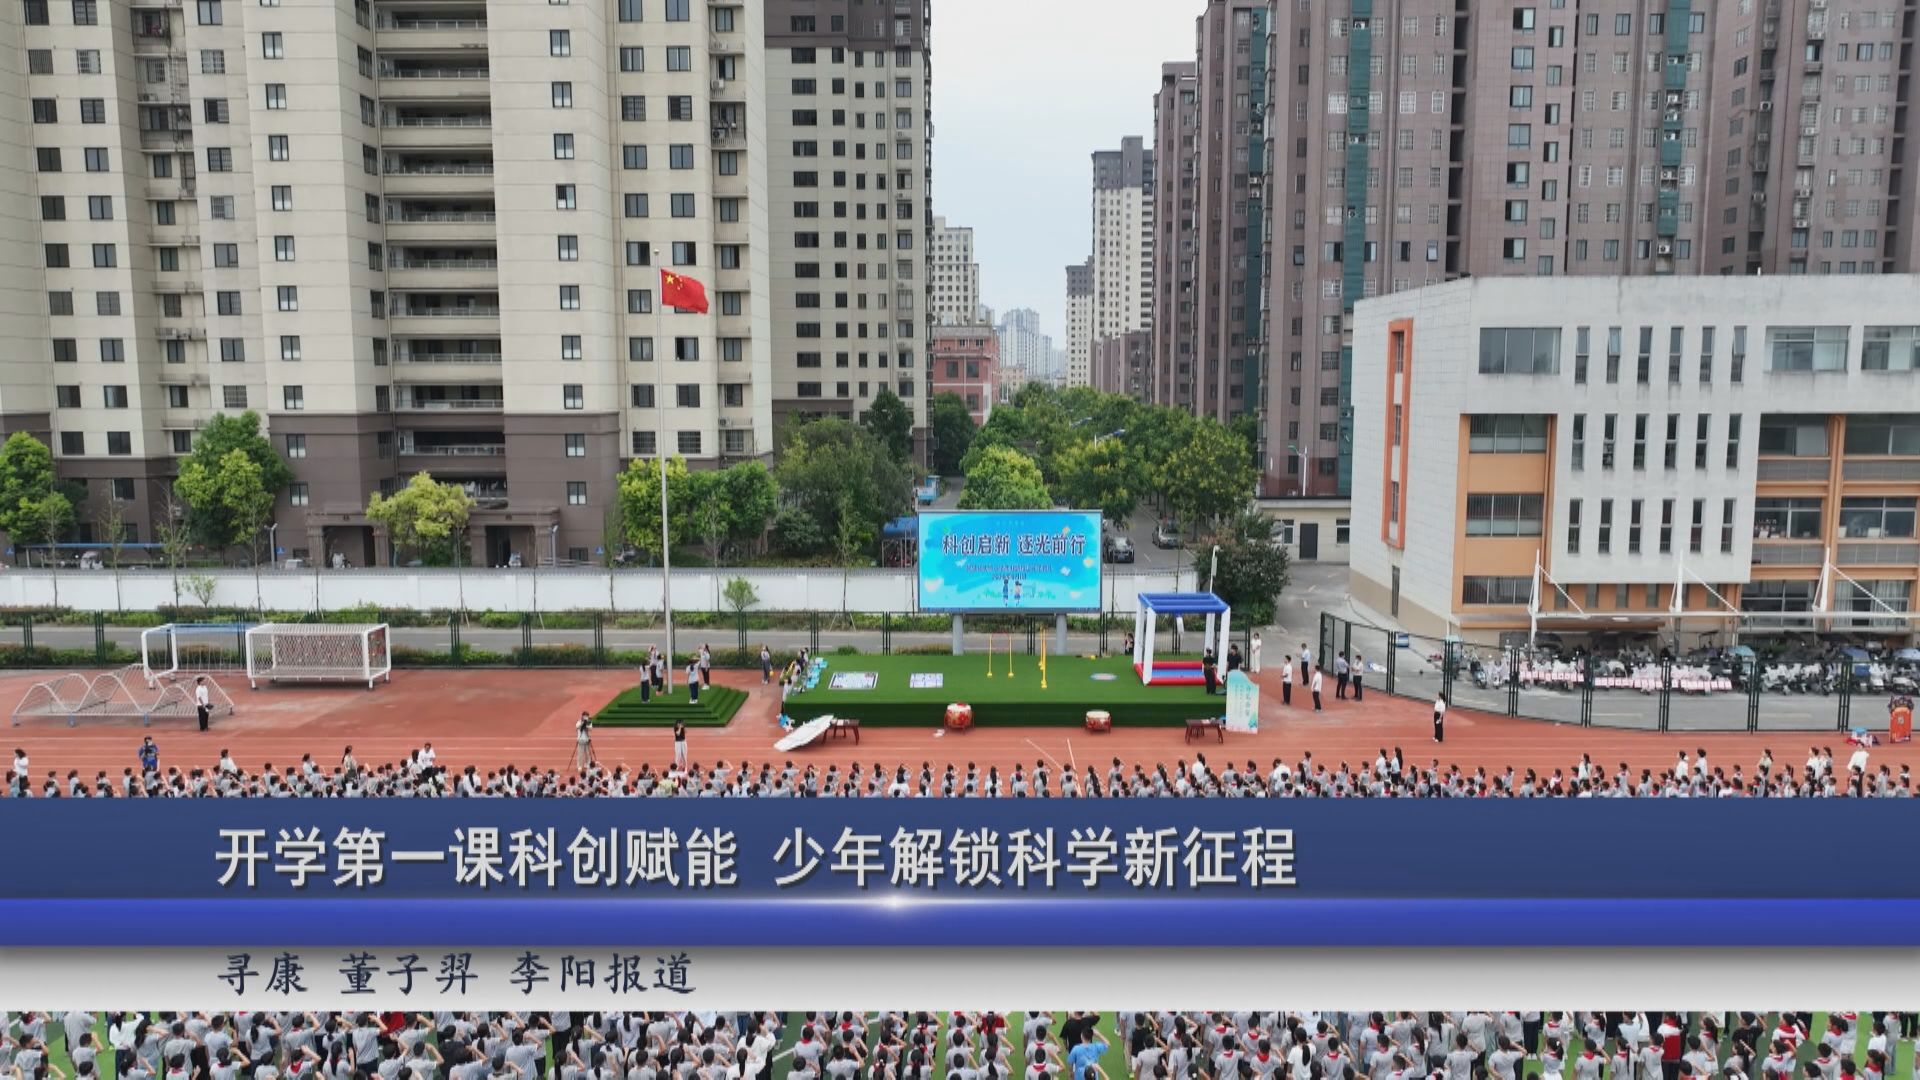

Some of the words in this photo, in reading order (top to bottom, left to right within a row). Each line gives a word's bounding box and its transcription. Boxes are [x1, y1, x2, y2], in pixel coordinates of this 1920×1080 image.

[943, 534, 1010, 555] 科创启新
[1017, 534, 1085, 555] 逐光前行
